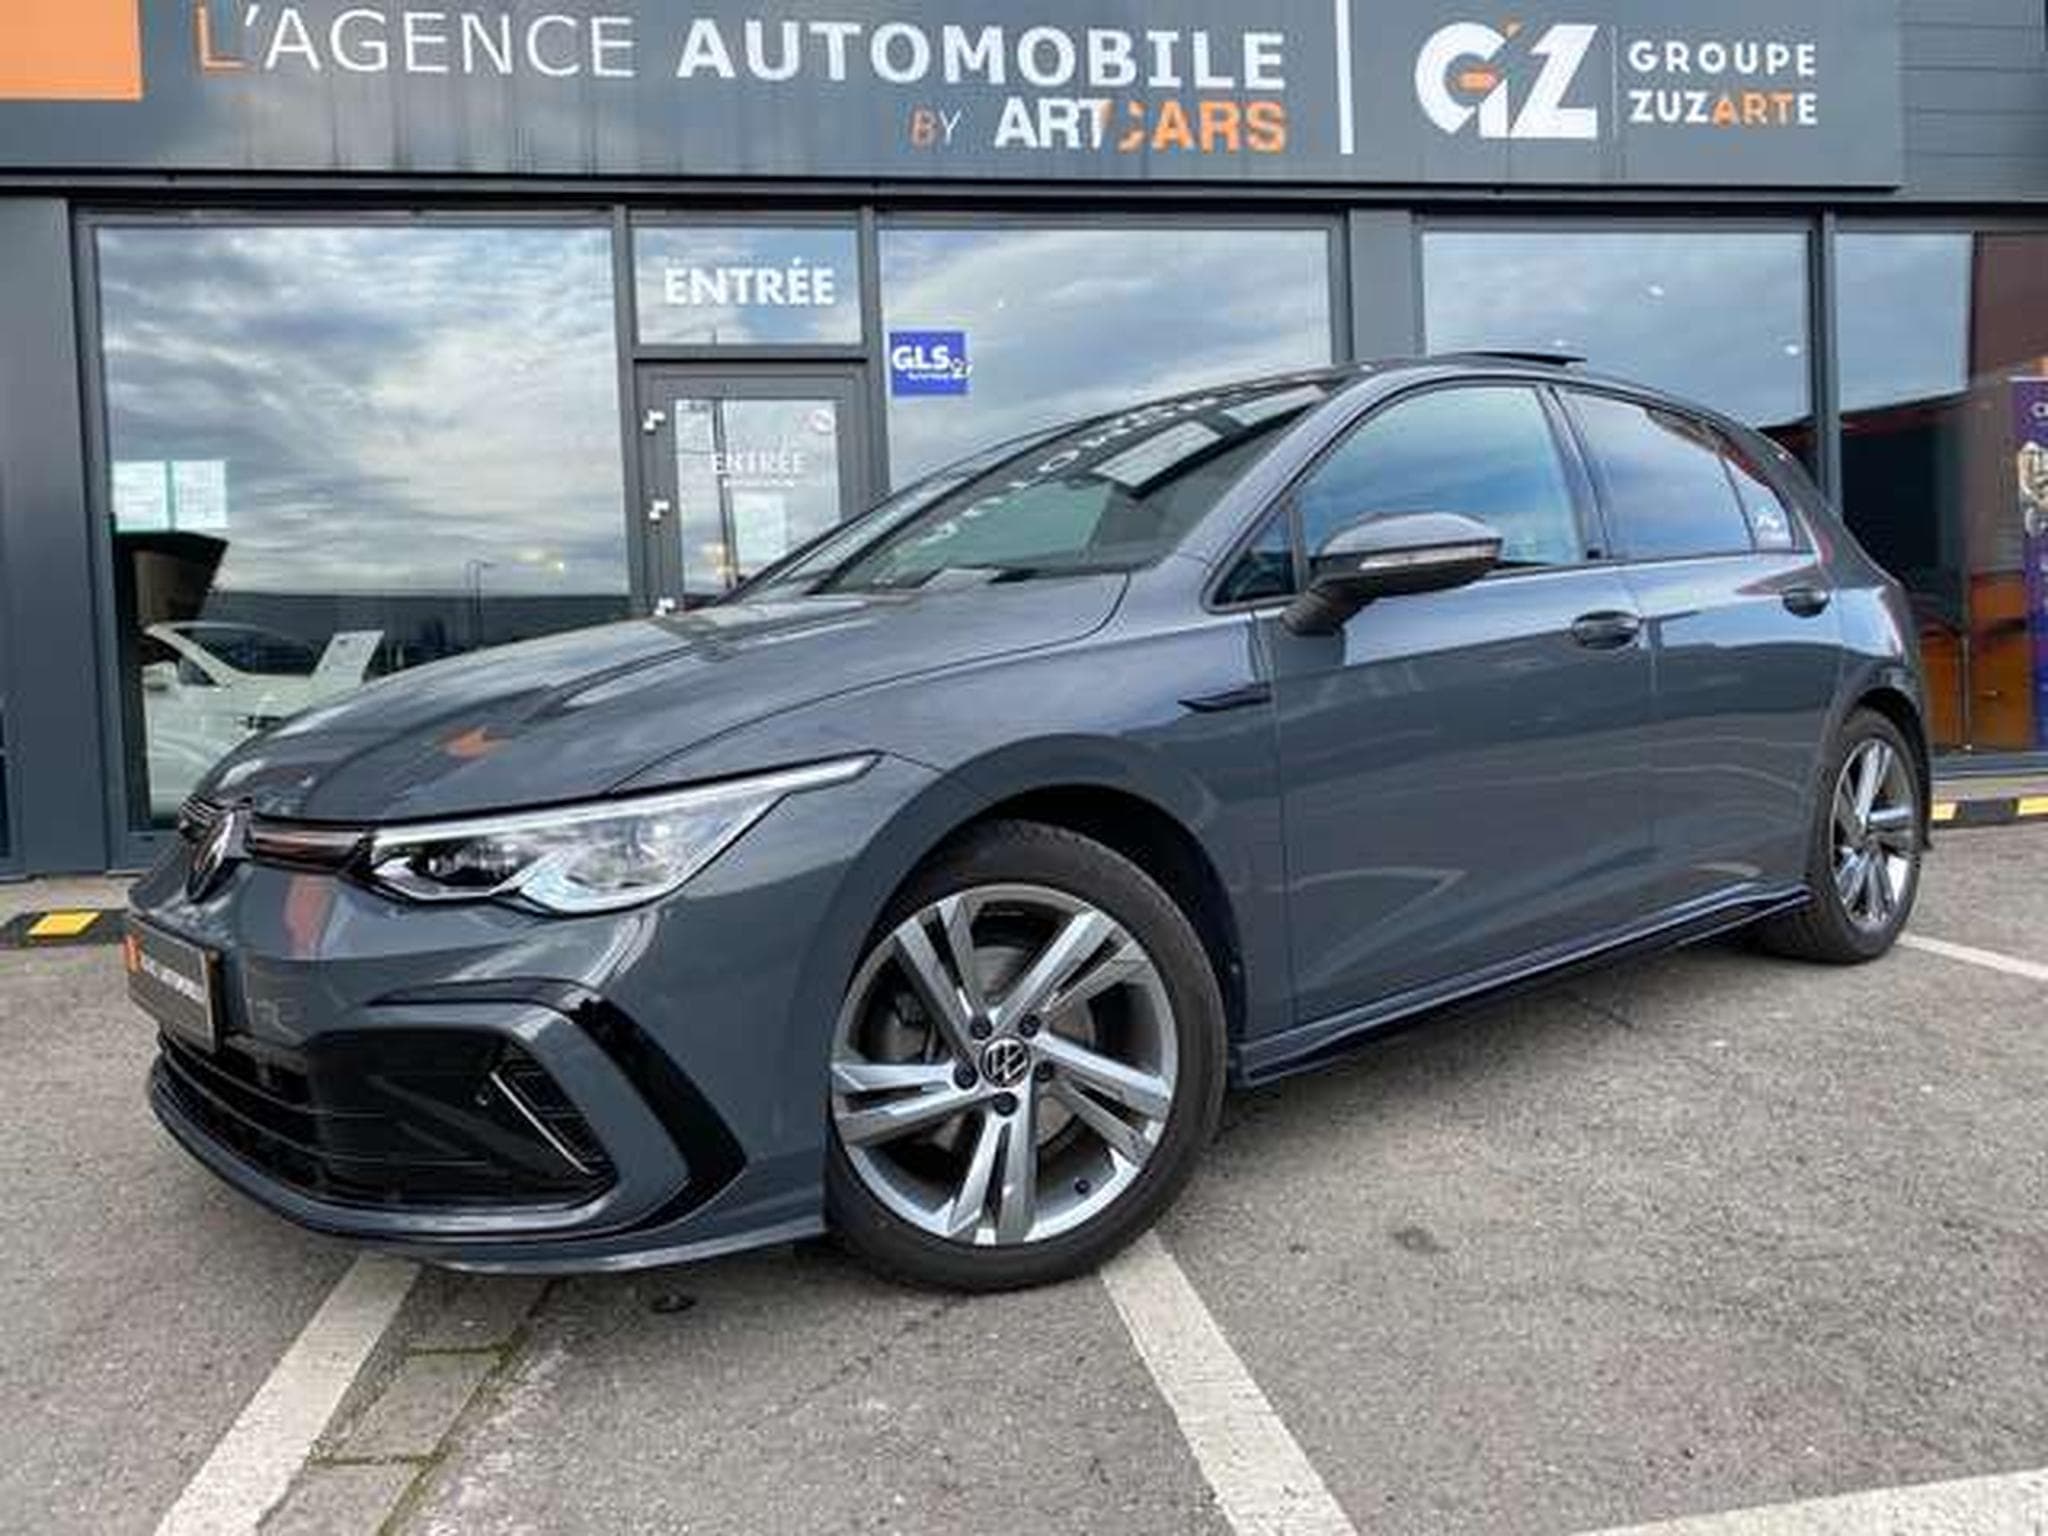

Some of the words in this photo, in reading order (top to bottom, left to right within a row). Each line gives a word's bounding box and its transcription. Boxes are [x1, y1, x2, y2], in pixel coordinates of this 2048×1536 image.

[194, 2, 638, 78] L'AGENCE
[676, 18, 1287, 91] AUTOMOBILE
[1627, 40, 1818, 77] GROUPE
[909, 107, 963, 146] BY
[1627, 89, 1819, 127] ZUZARTE
[663, 256, 836, 306] ENTRÉE
[892, 345, 950, 371] GLS
